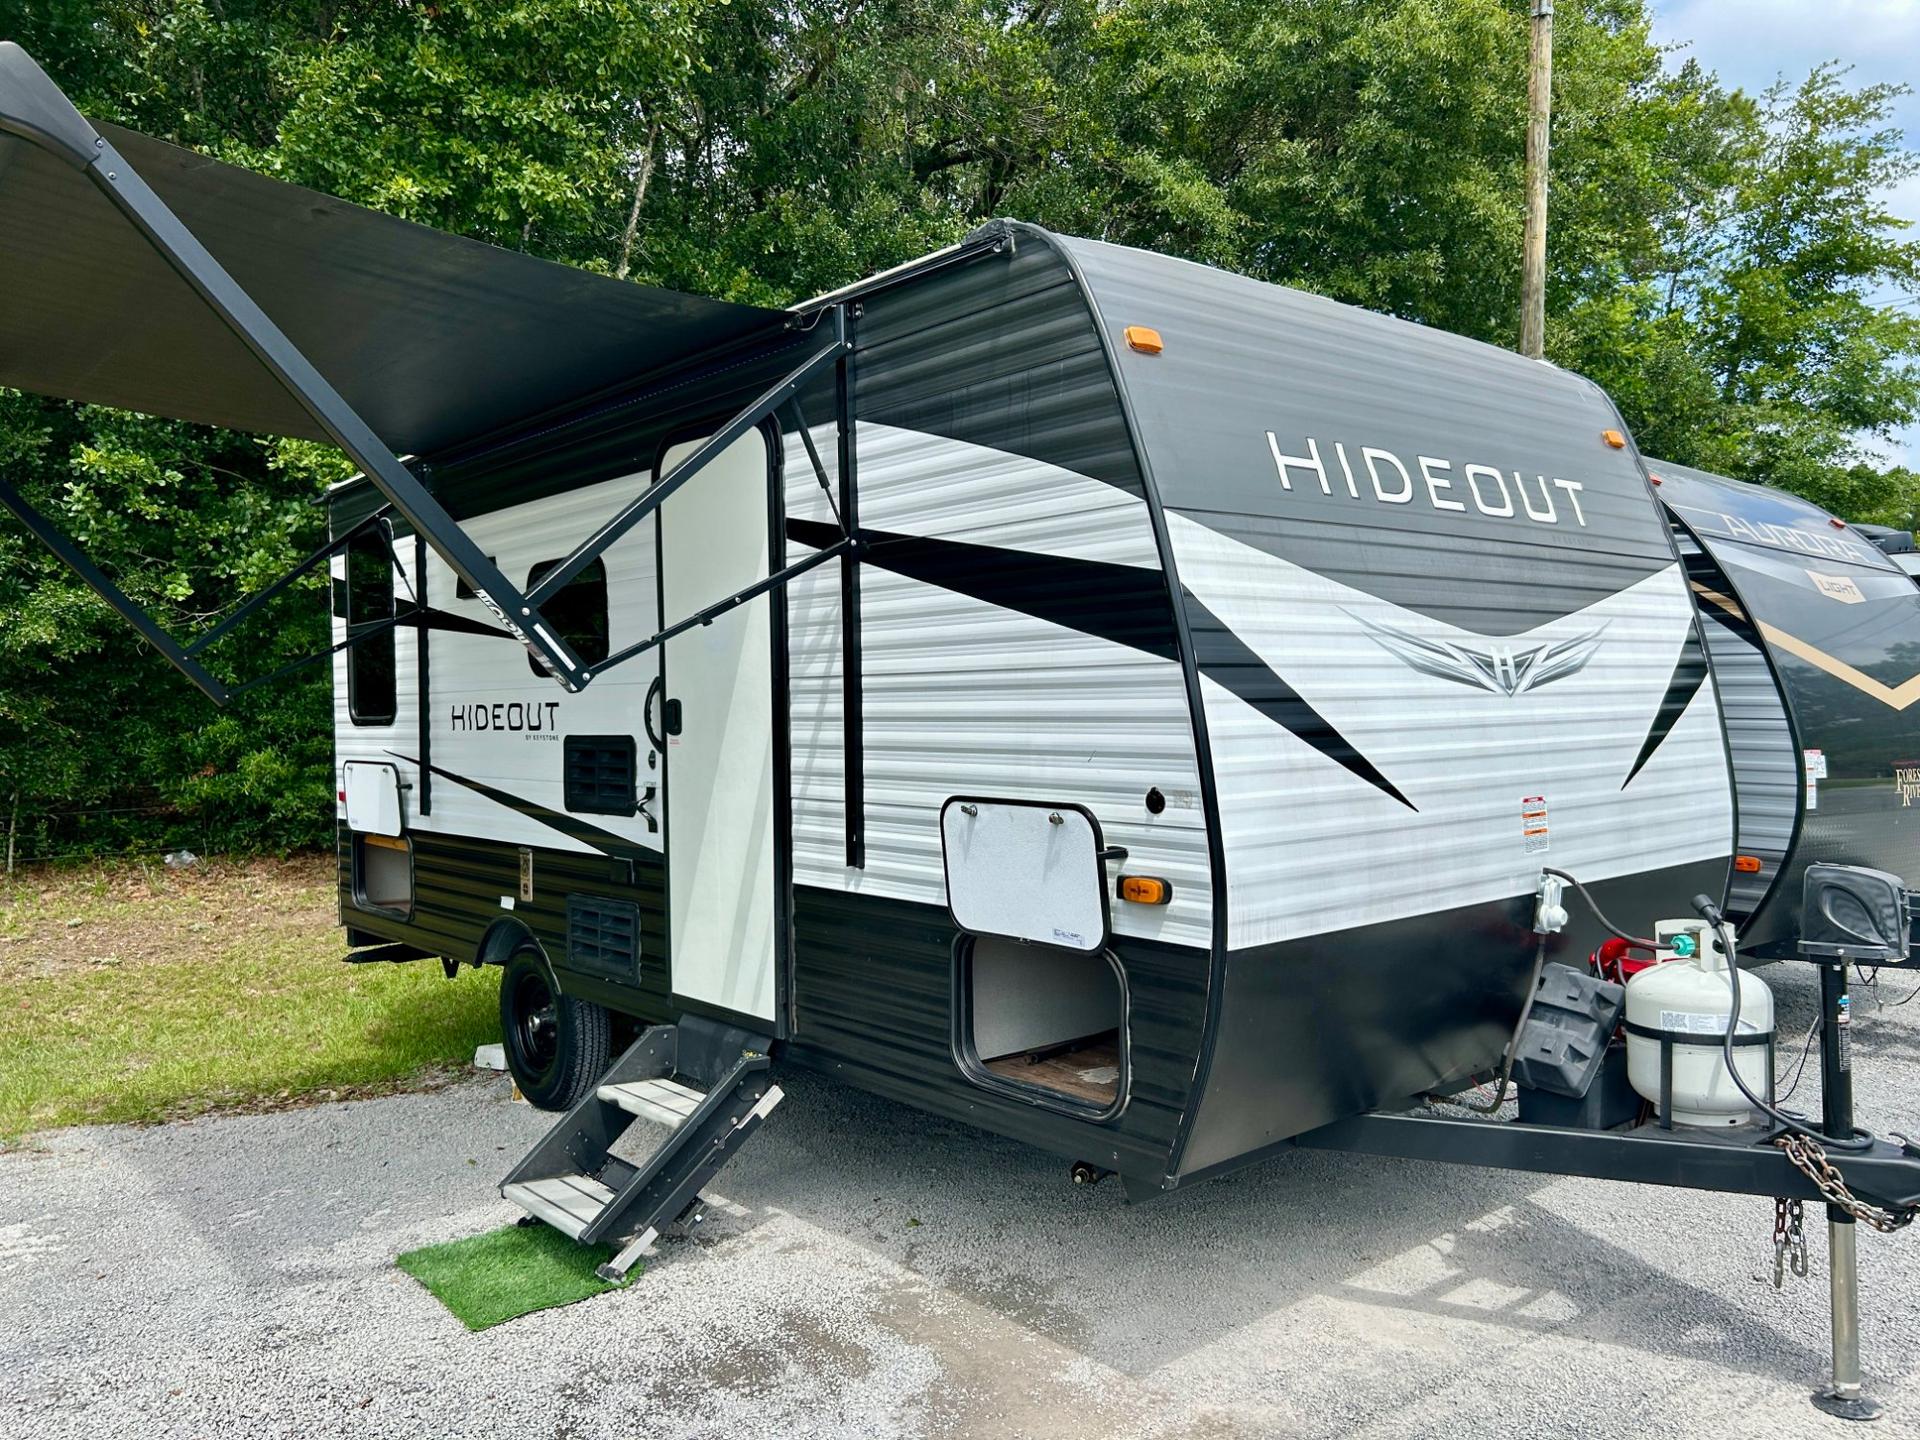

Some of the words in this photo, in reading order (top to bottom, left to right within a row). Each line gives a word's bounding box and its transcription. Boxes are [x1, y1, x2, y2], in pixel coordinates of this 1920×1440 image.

[1265, 430, 1587, 527] HIDEOUT
[1720, 512, 1873, 563] AURORA
[1817, 578, 1858, 597] LIGHT
[451, 701, 560, 731] HIDEOUT
[1894, 767, 1920, 794] FORES
[1902, 784, 1920, 807] RIVE
